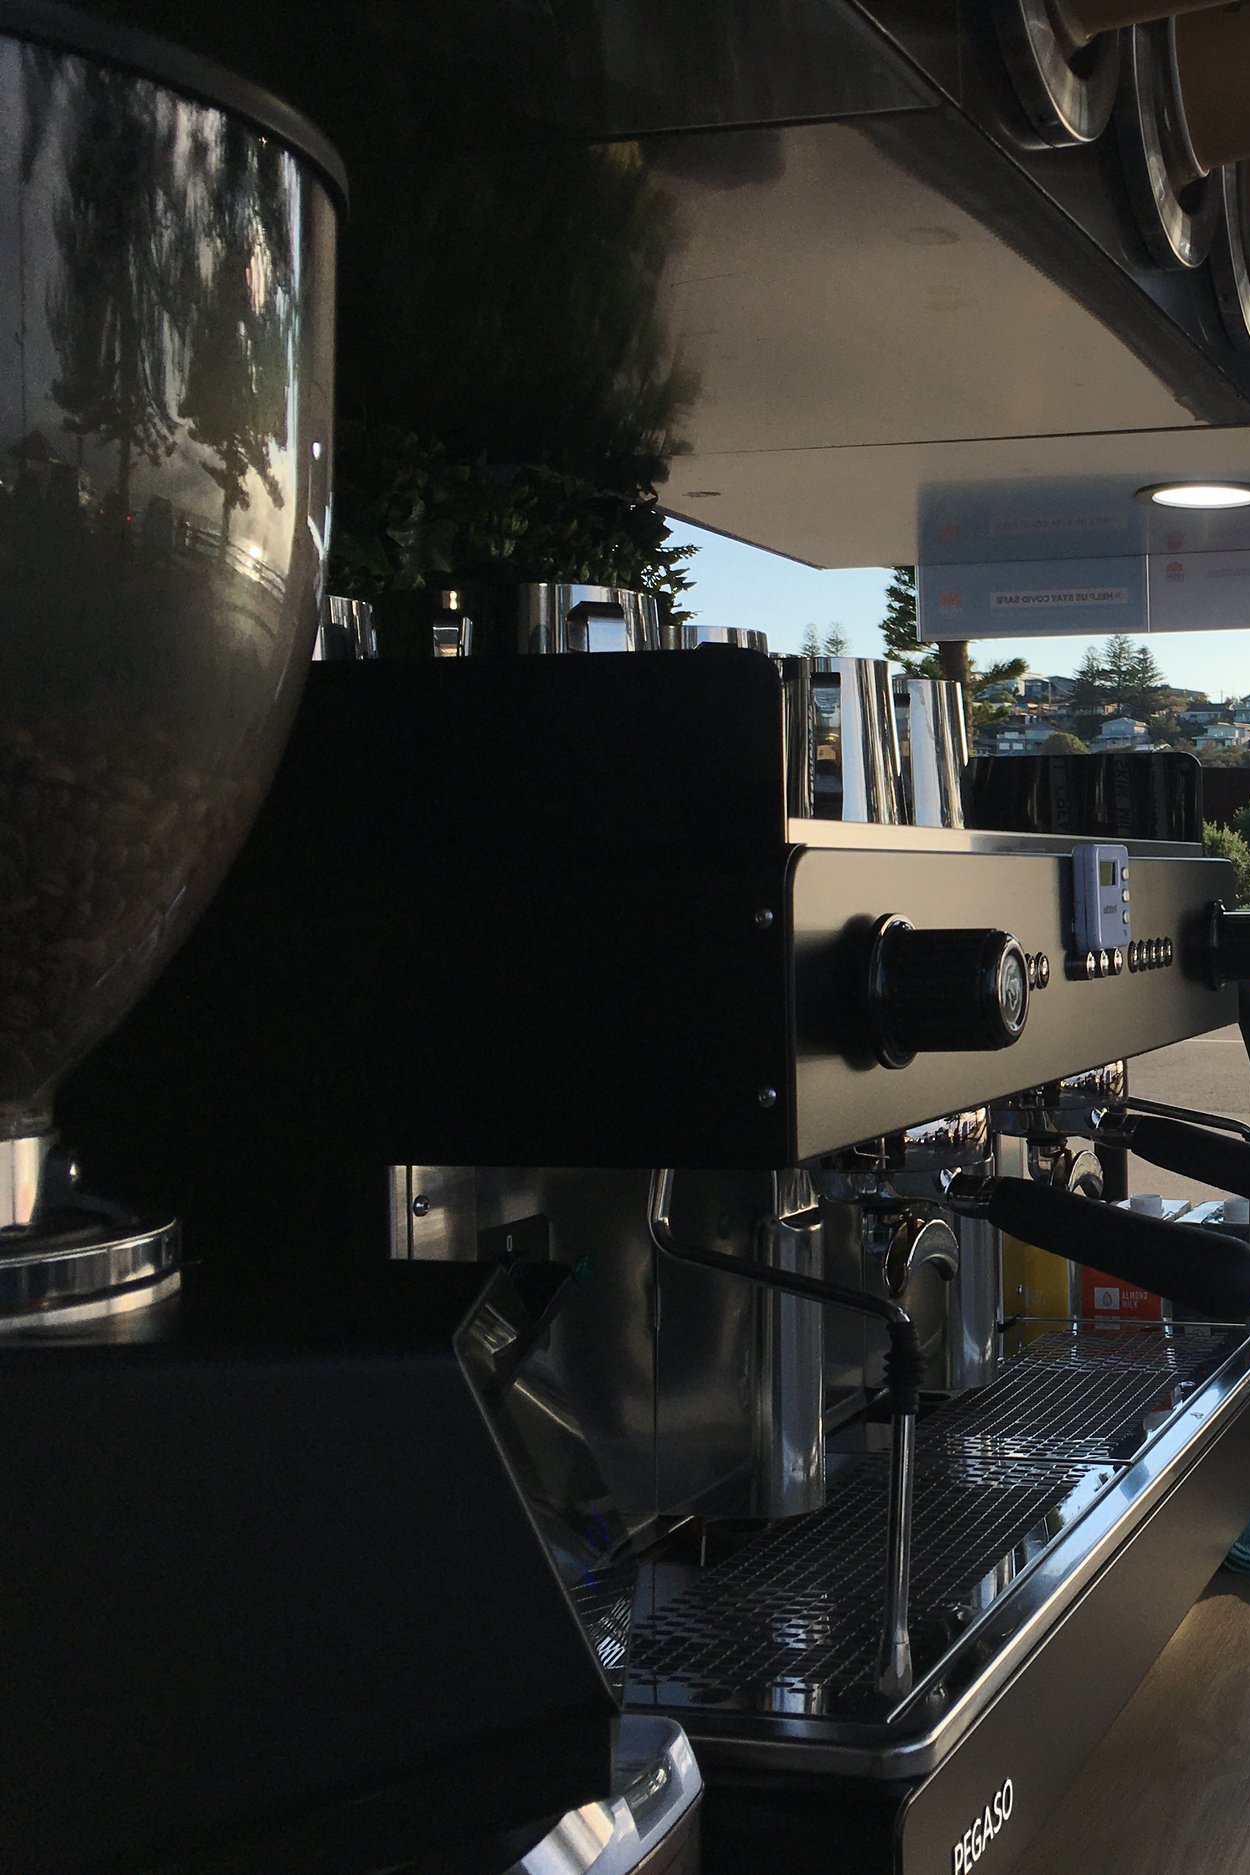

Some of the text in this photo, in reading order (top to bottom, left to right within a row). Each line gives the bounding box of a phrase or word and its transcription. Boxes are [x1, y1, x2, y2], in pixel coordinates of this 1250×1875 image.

[1121, 1291, 1149, 1301] ALMOND
[1121, 1300, 1139, 1309] MILK
[954, 1778, 1013, 1875] PEGASO
